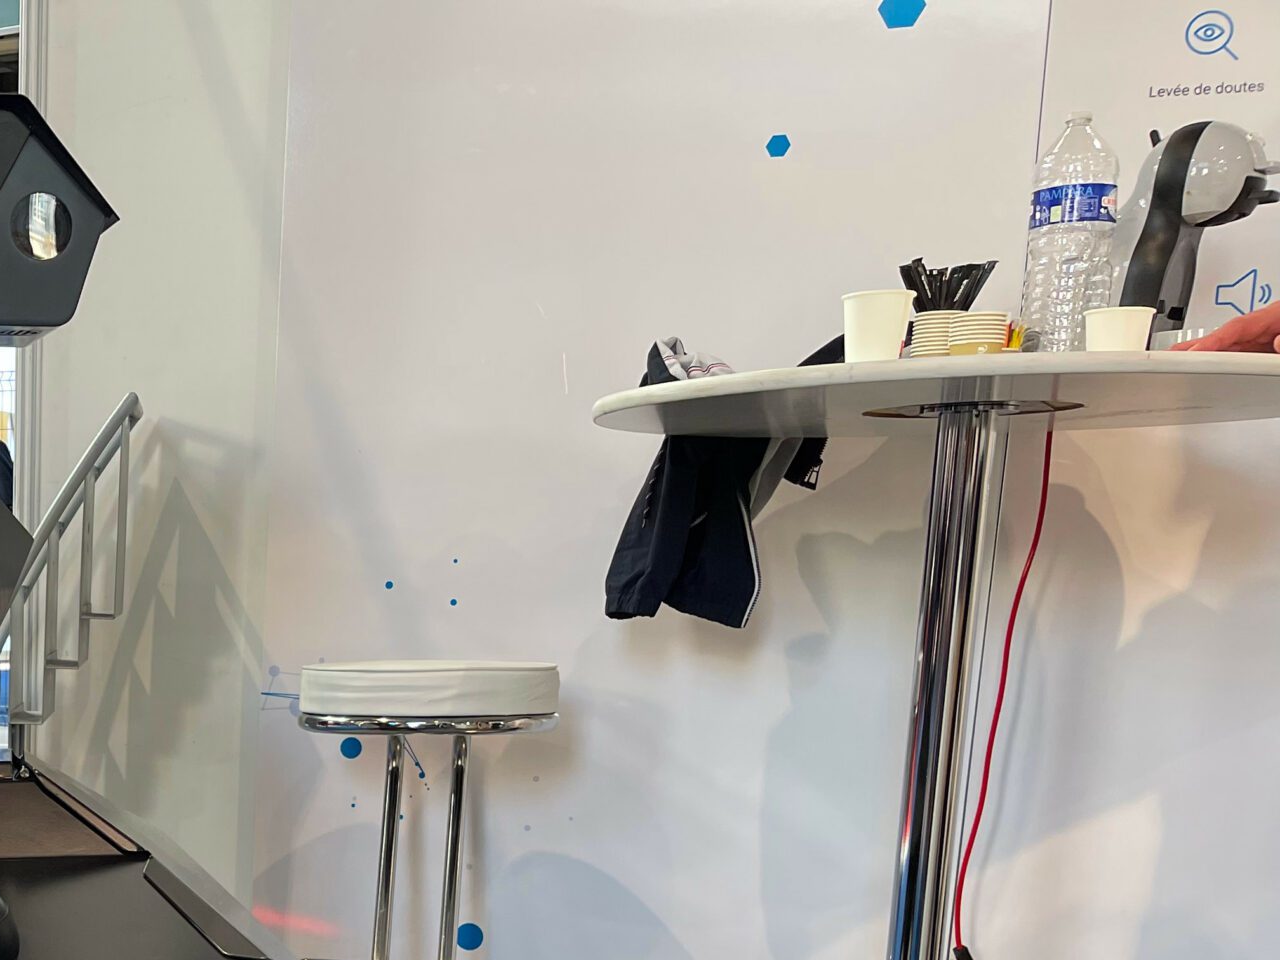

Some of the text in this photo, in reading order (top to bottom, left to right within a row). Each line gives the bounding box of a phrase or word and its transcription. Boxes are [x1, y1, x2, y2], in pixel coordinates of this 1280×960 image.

[1148, 82, 1265, 98] Levée de doutes
